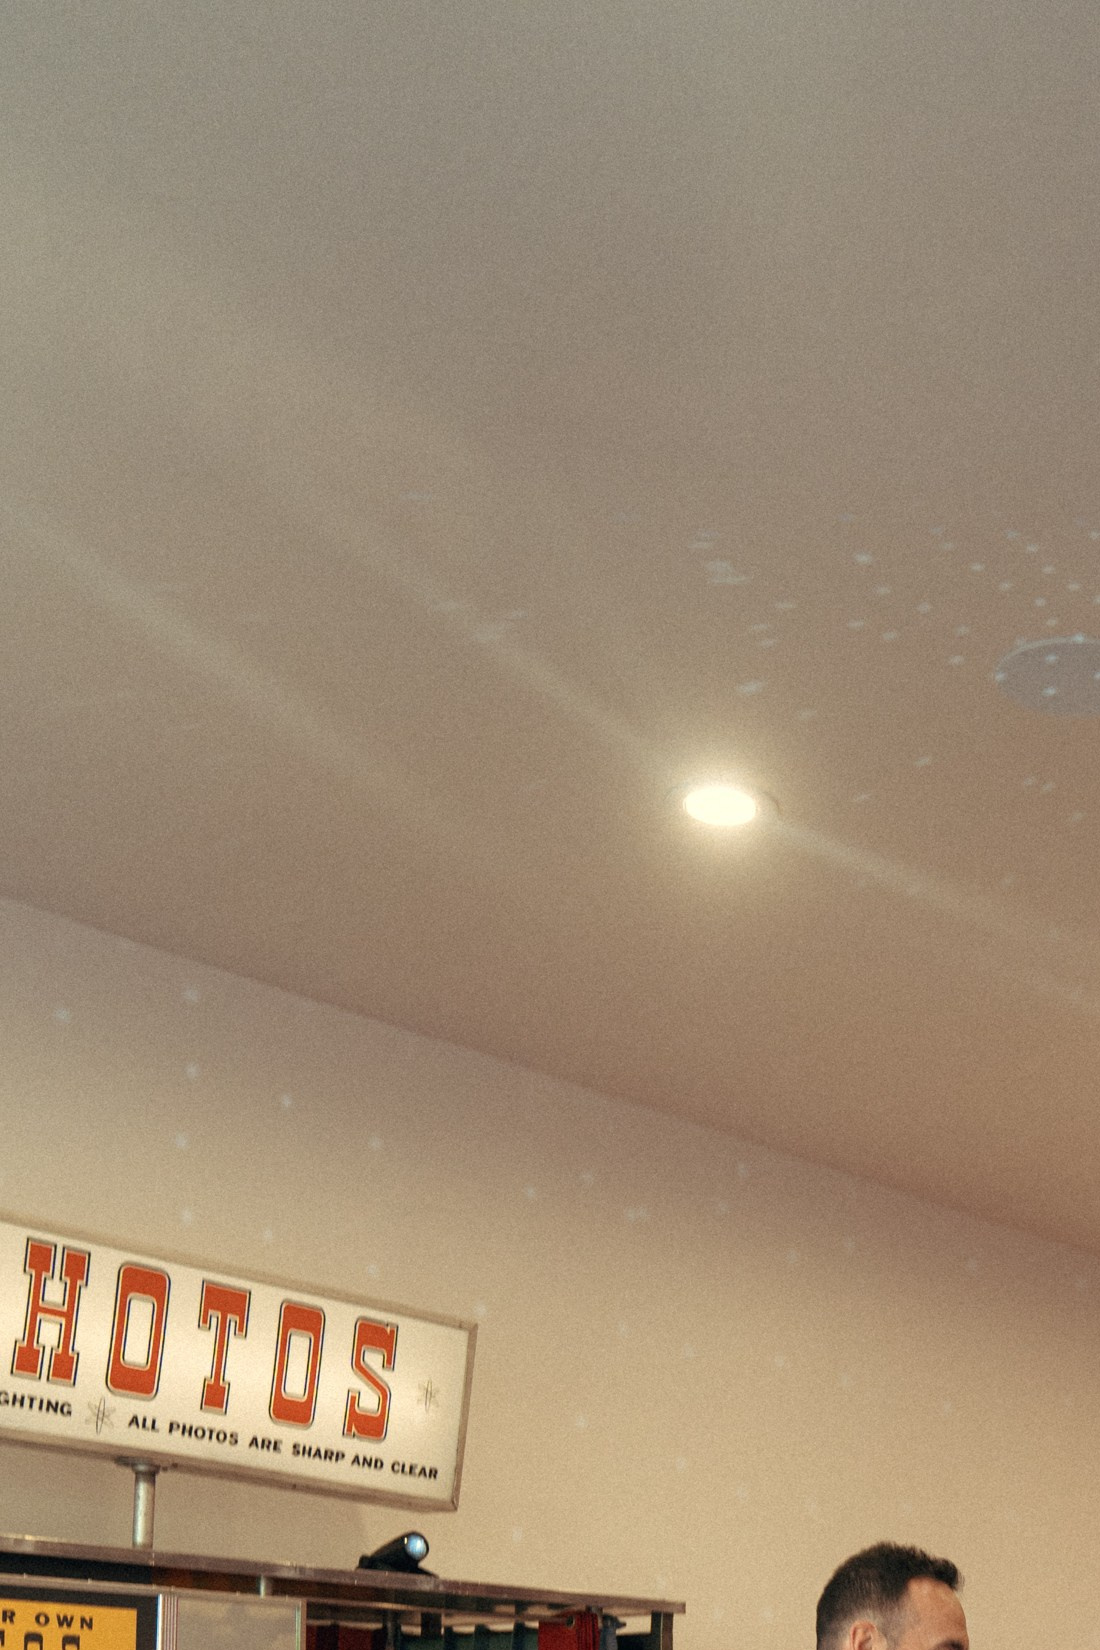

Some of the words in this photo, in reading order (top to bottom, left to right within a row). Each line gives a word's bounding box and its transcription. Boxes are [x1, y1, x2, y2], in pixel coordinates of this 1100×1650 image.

[10, 1237, 398, 1442] HOTOS
[128, 1414, 160, 1432] ALL
[168, 1420, 239, 1446] PHOTOS
[248, 1436, 282, 1454] ARE
[292, 1443, 345, 1463] SHARP
[351, 1453, 384, 1471] AND
[391, 1461, 438, 1480] CLEAR
[35, 1612, 93, 1630] OWN
